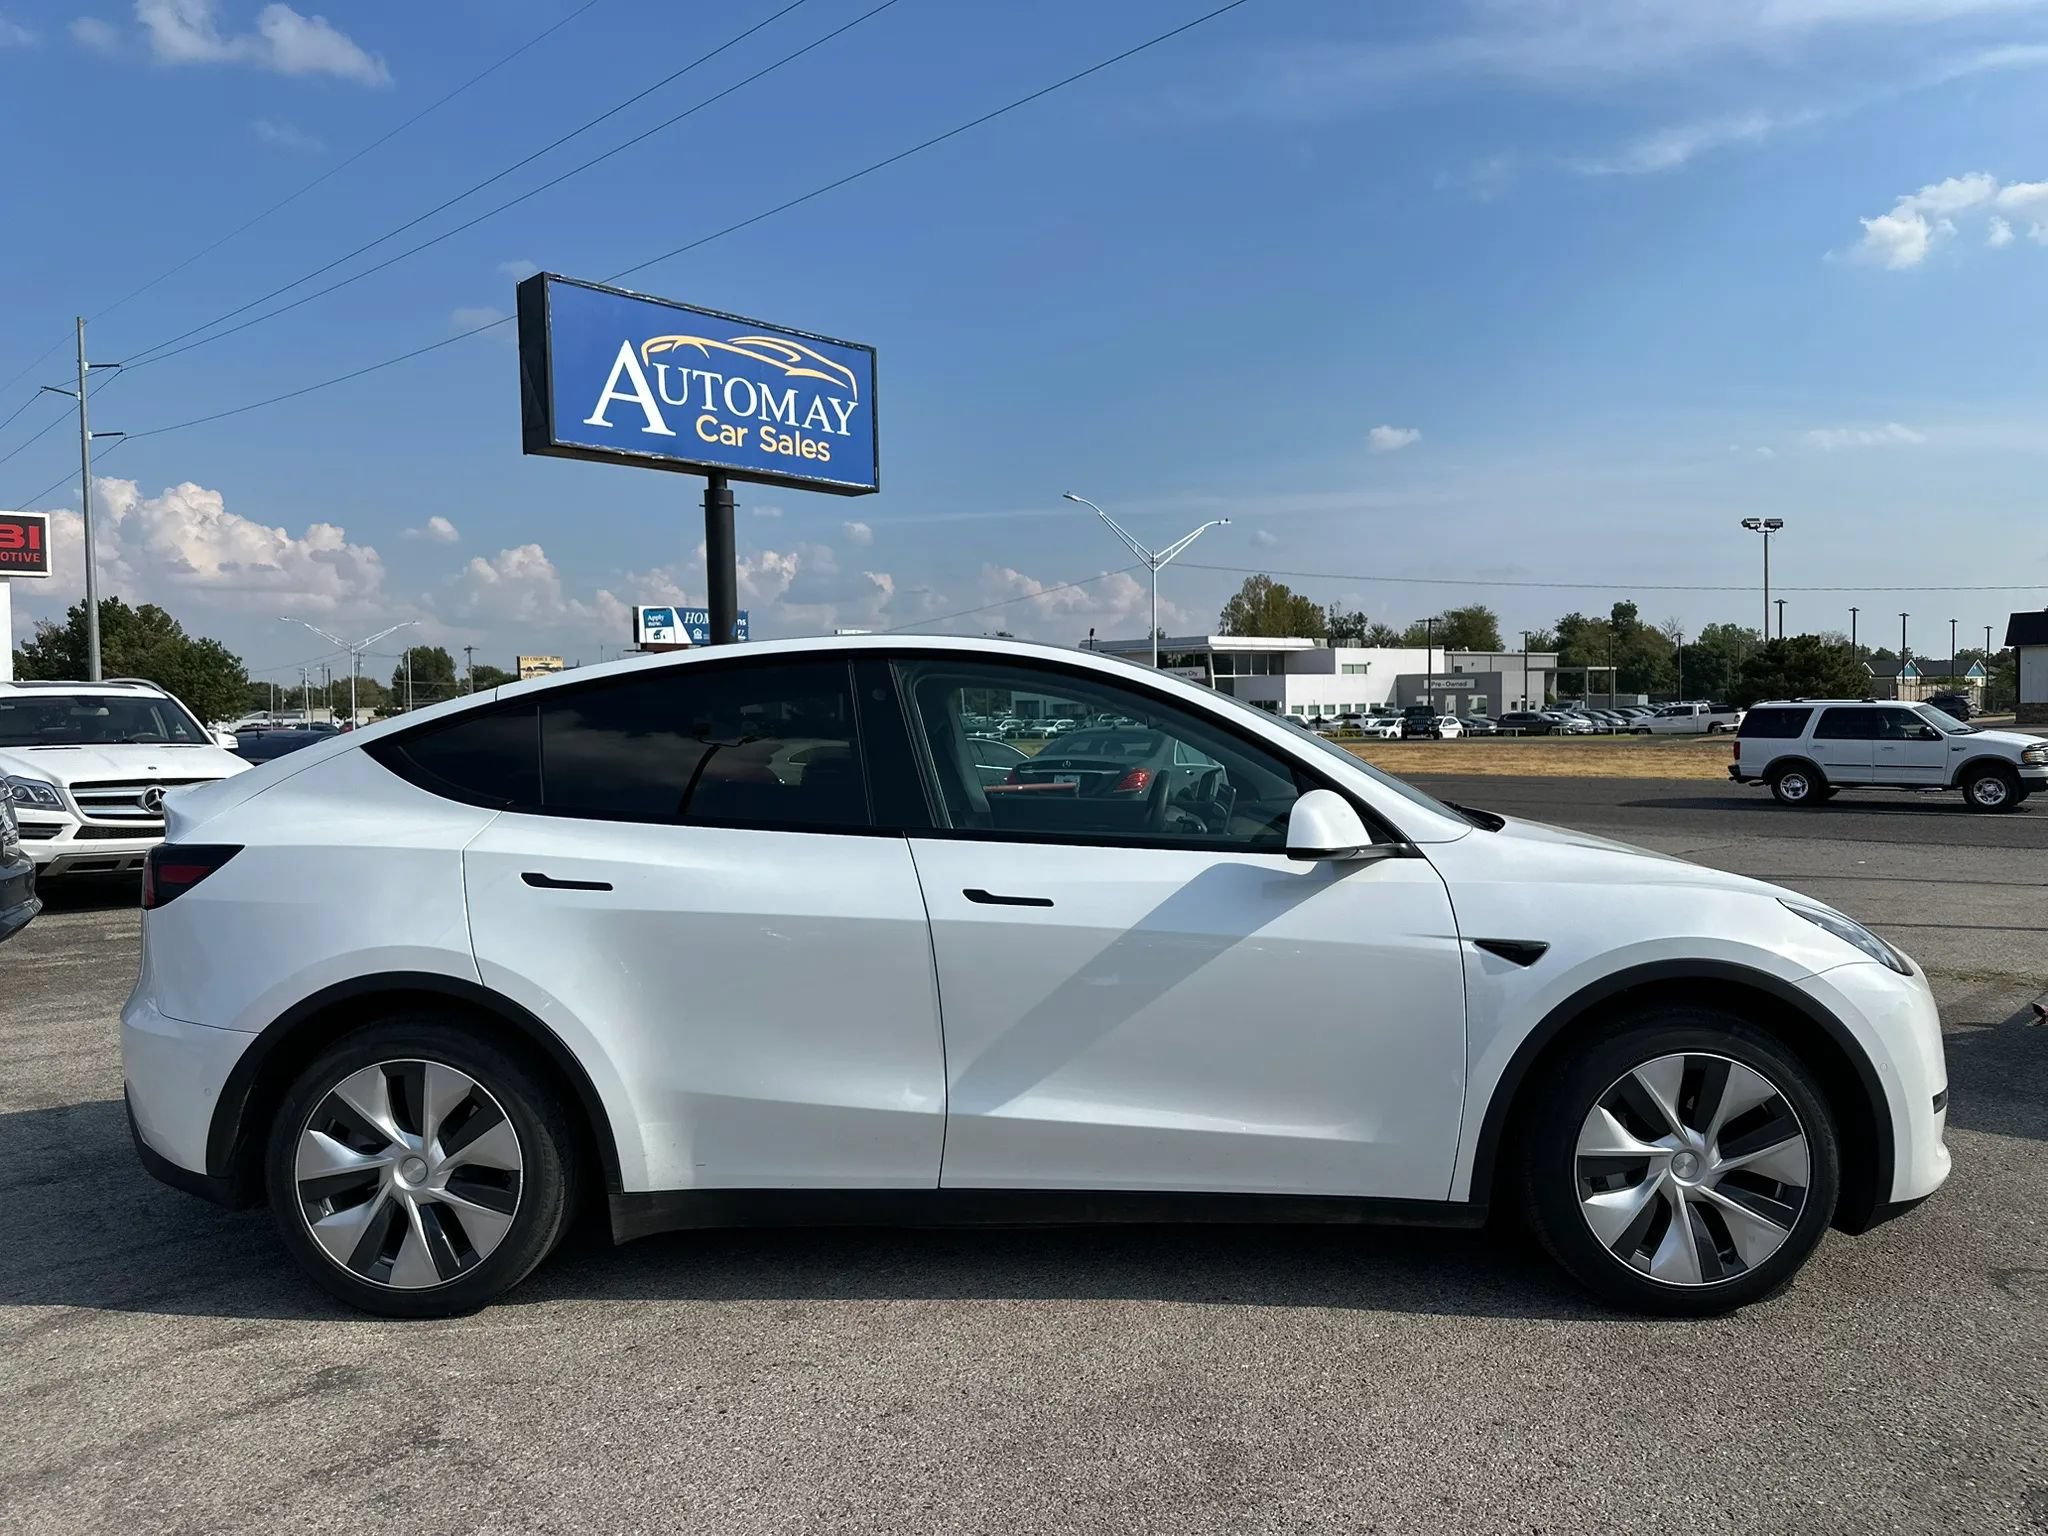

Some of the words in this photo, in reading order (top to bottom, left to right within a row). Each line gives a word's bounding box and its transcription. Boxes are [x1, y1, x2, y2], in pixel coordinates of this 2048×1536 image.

[583, 339, 859, 437] AUTOMAY
[695, 414, 748, 447] Car
[759, 425, 831, 462] Sales
